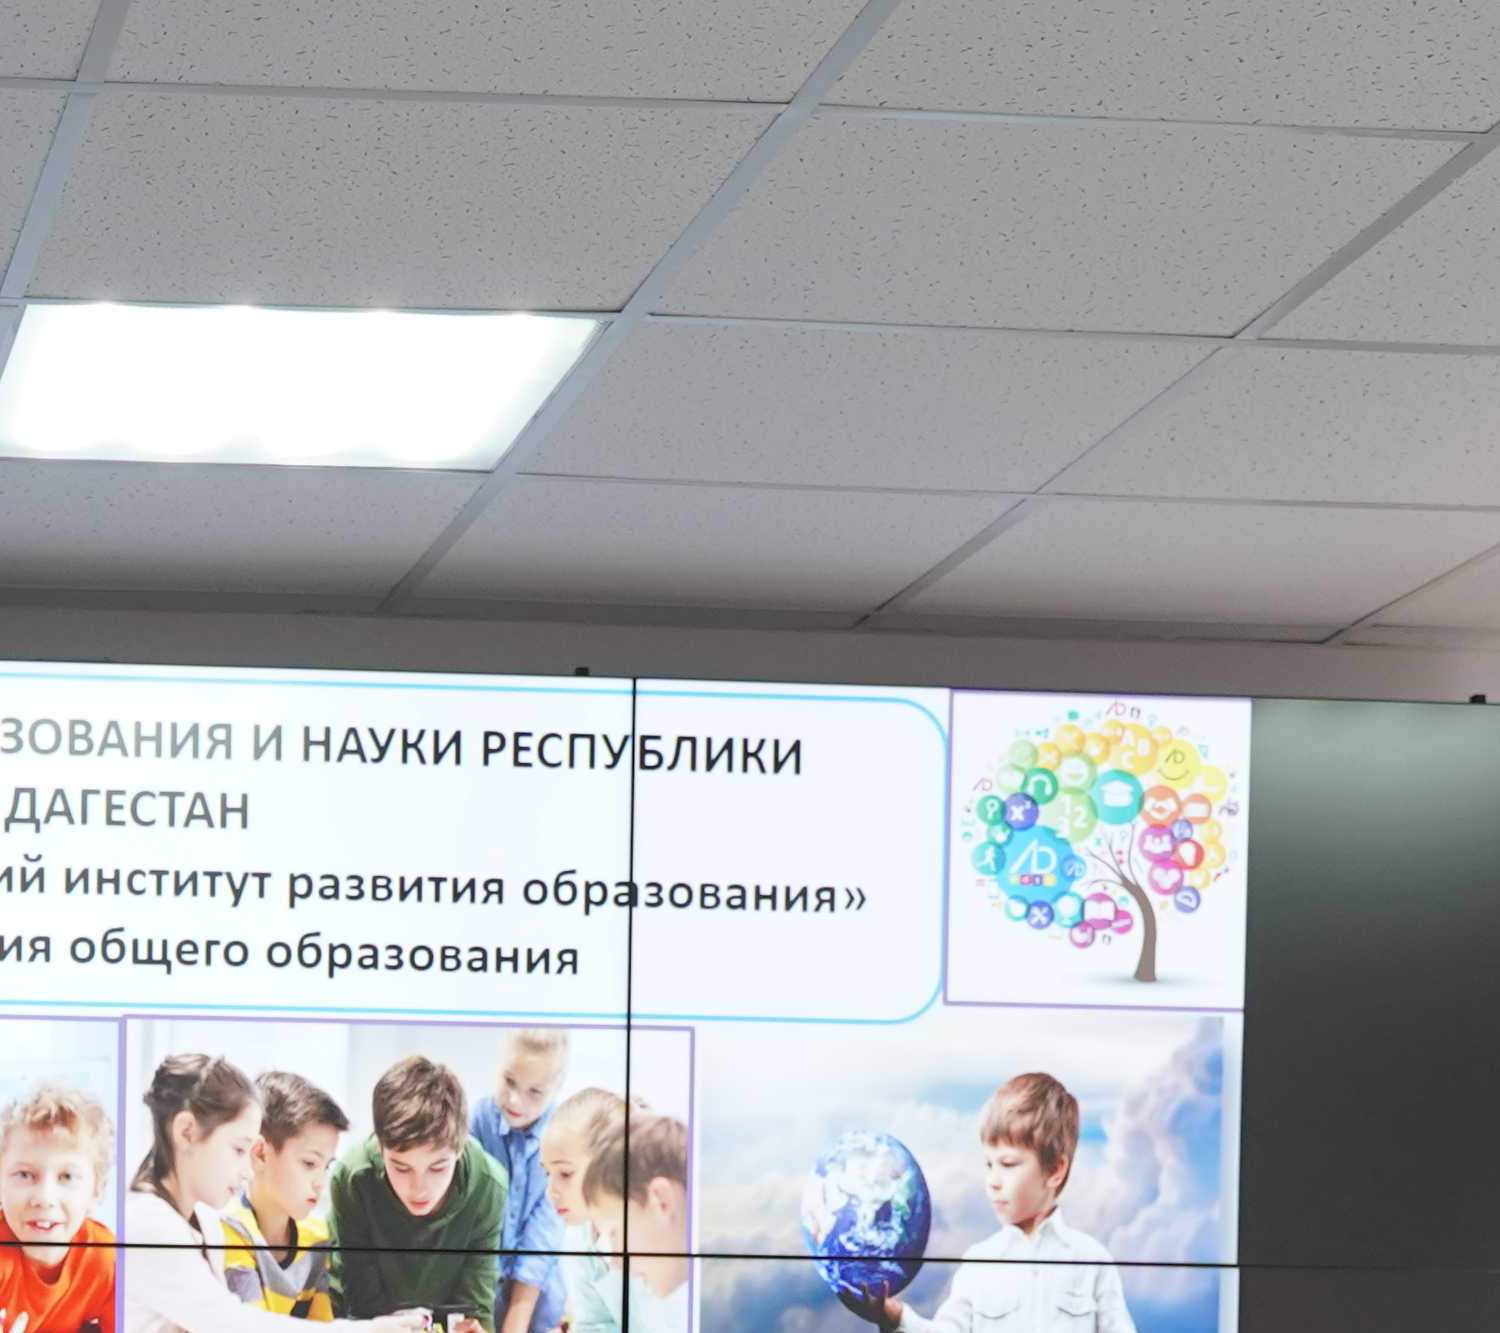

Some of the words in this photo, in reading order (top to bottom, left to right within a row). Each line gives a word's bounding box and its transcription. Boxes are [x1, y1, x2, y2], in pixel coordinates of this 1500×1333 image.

[254, 725, 281, 761] И
[304, 726, 461, 766] НАУКИ
[483, 731, 801, 776] РЕСПУБЛИКИ
[5, 788, 248, 834] ДАГЕСТАН
[65, 867, 272, 908] институт
[288, 873, 504, 910] развития
[523, 868, 867, 917] образования»
[69, 928, 249, 975] общего
[266, 931, 578, 979] образования
